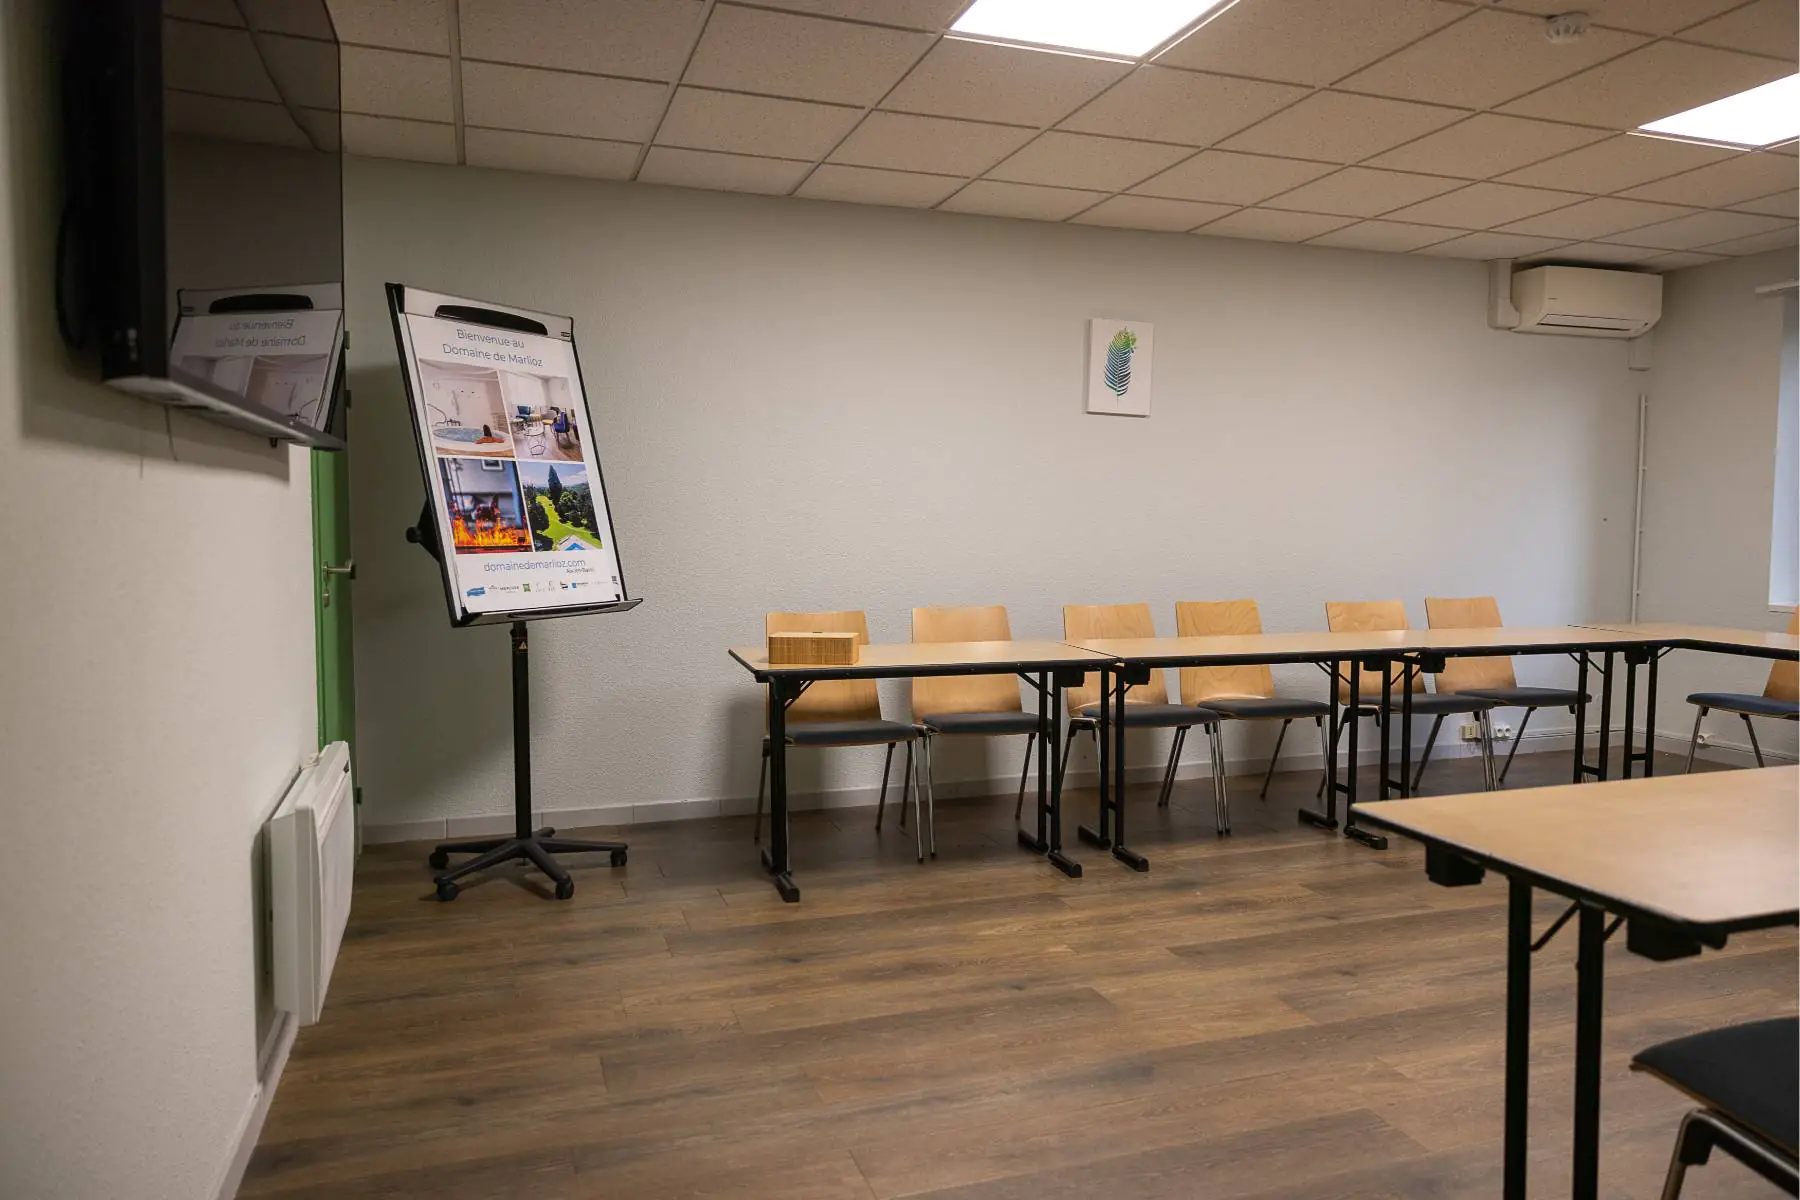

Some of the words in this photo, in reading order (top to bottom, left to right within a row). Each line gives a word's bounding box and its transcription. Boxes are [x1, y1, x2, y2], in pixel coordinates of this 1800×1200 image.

[456, 328, 511, 346] Bienvenue
[512, 339, 525, 349] au
[442, 343, 492, 360] Domaine
[493, 351, 507, 362] de
[508, 353, 544, 367] Marlioz
